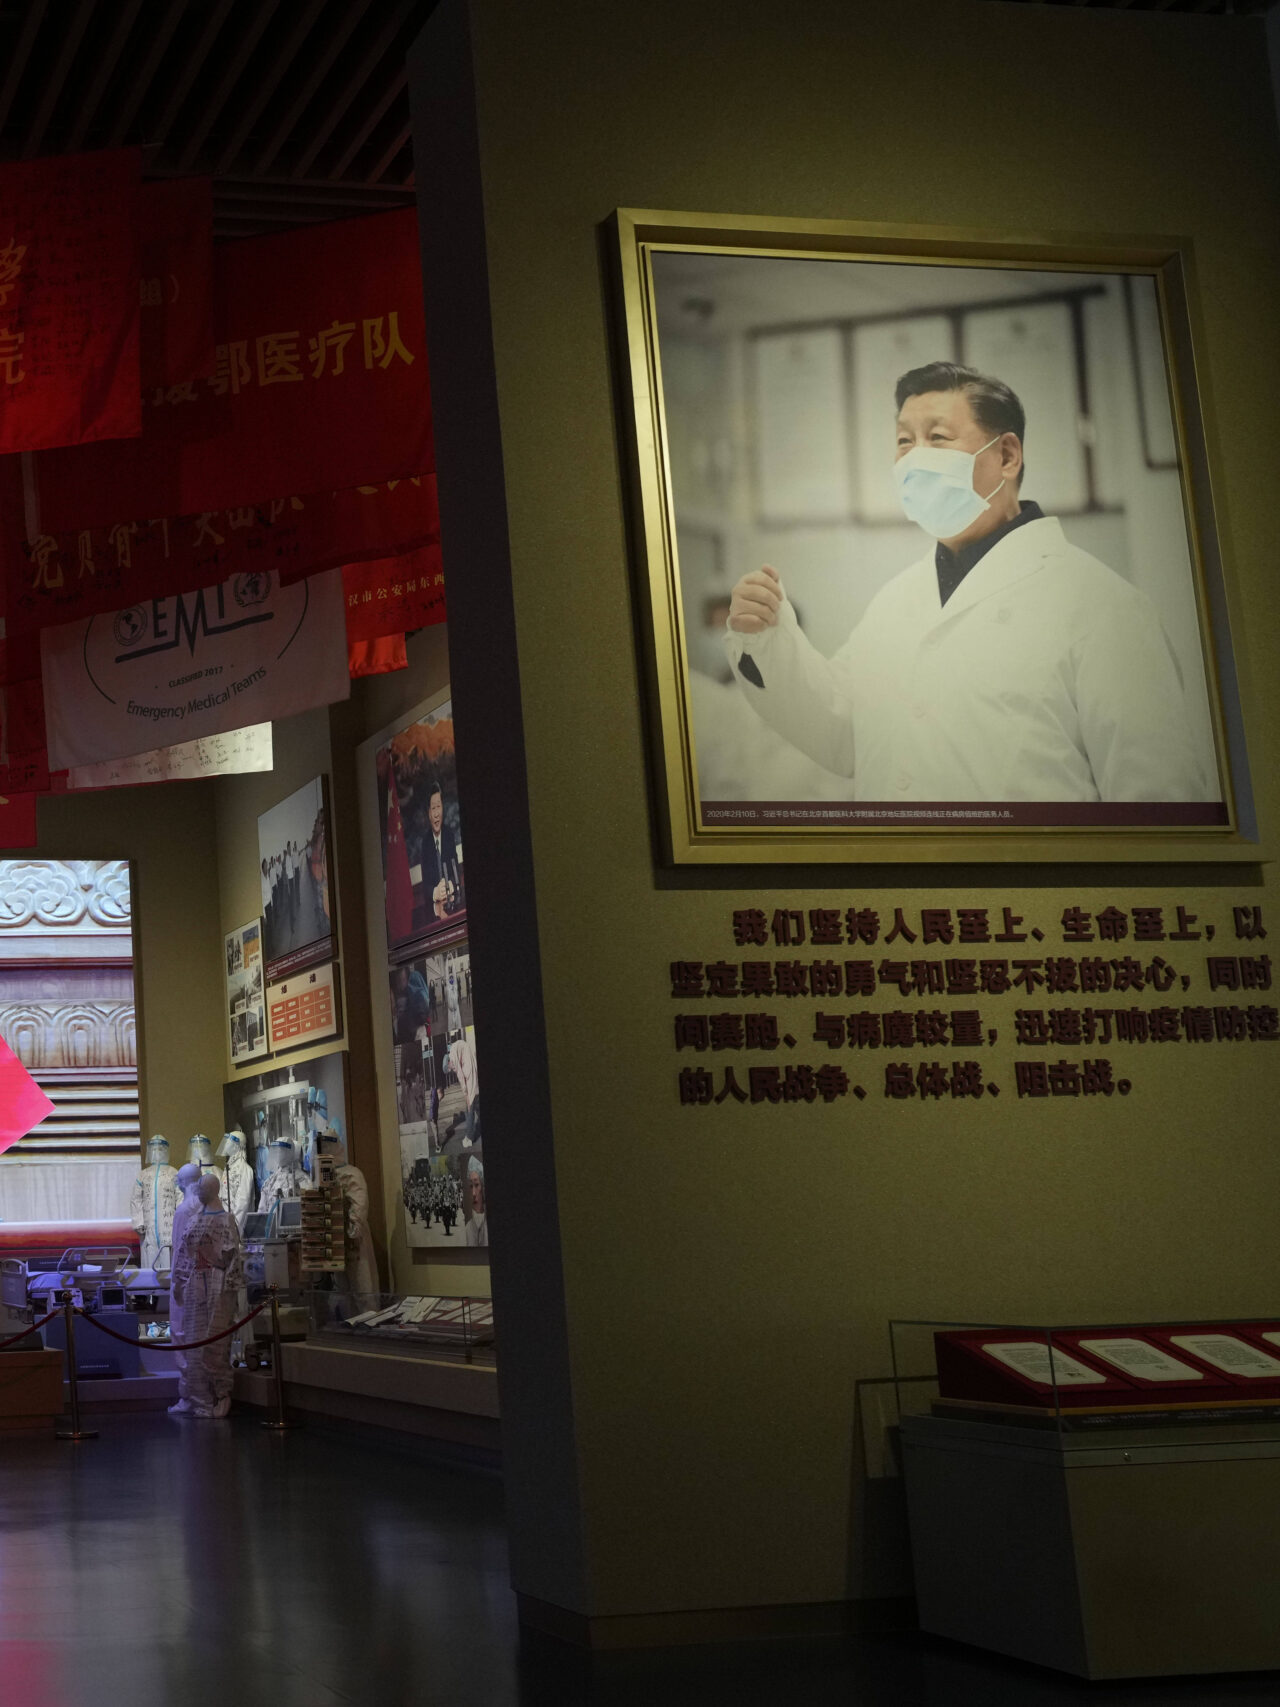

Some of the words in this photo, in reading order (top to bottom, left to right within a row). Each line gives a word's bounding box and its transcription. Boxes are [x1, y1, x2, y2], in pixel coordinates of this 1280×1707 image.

[126, 700, 186, 722] Emergency
[187, 686, 230, 714] Medical
[231, 666, 267, 696] Teams
[732, 905, 1268, 945] 我们坚持人民至上、生命至上，以
[670, 954, 1274, 999] 坚定果敢的勇气和坚忍不拔的决心，同时
[674, 1004, 1279, 1052] 间赛跑、与病魔较量，迅速打响疫情防控
[678, 1058, 1132, 1105] 的人民战争、总体战、阻击战。
